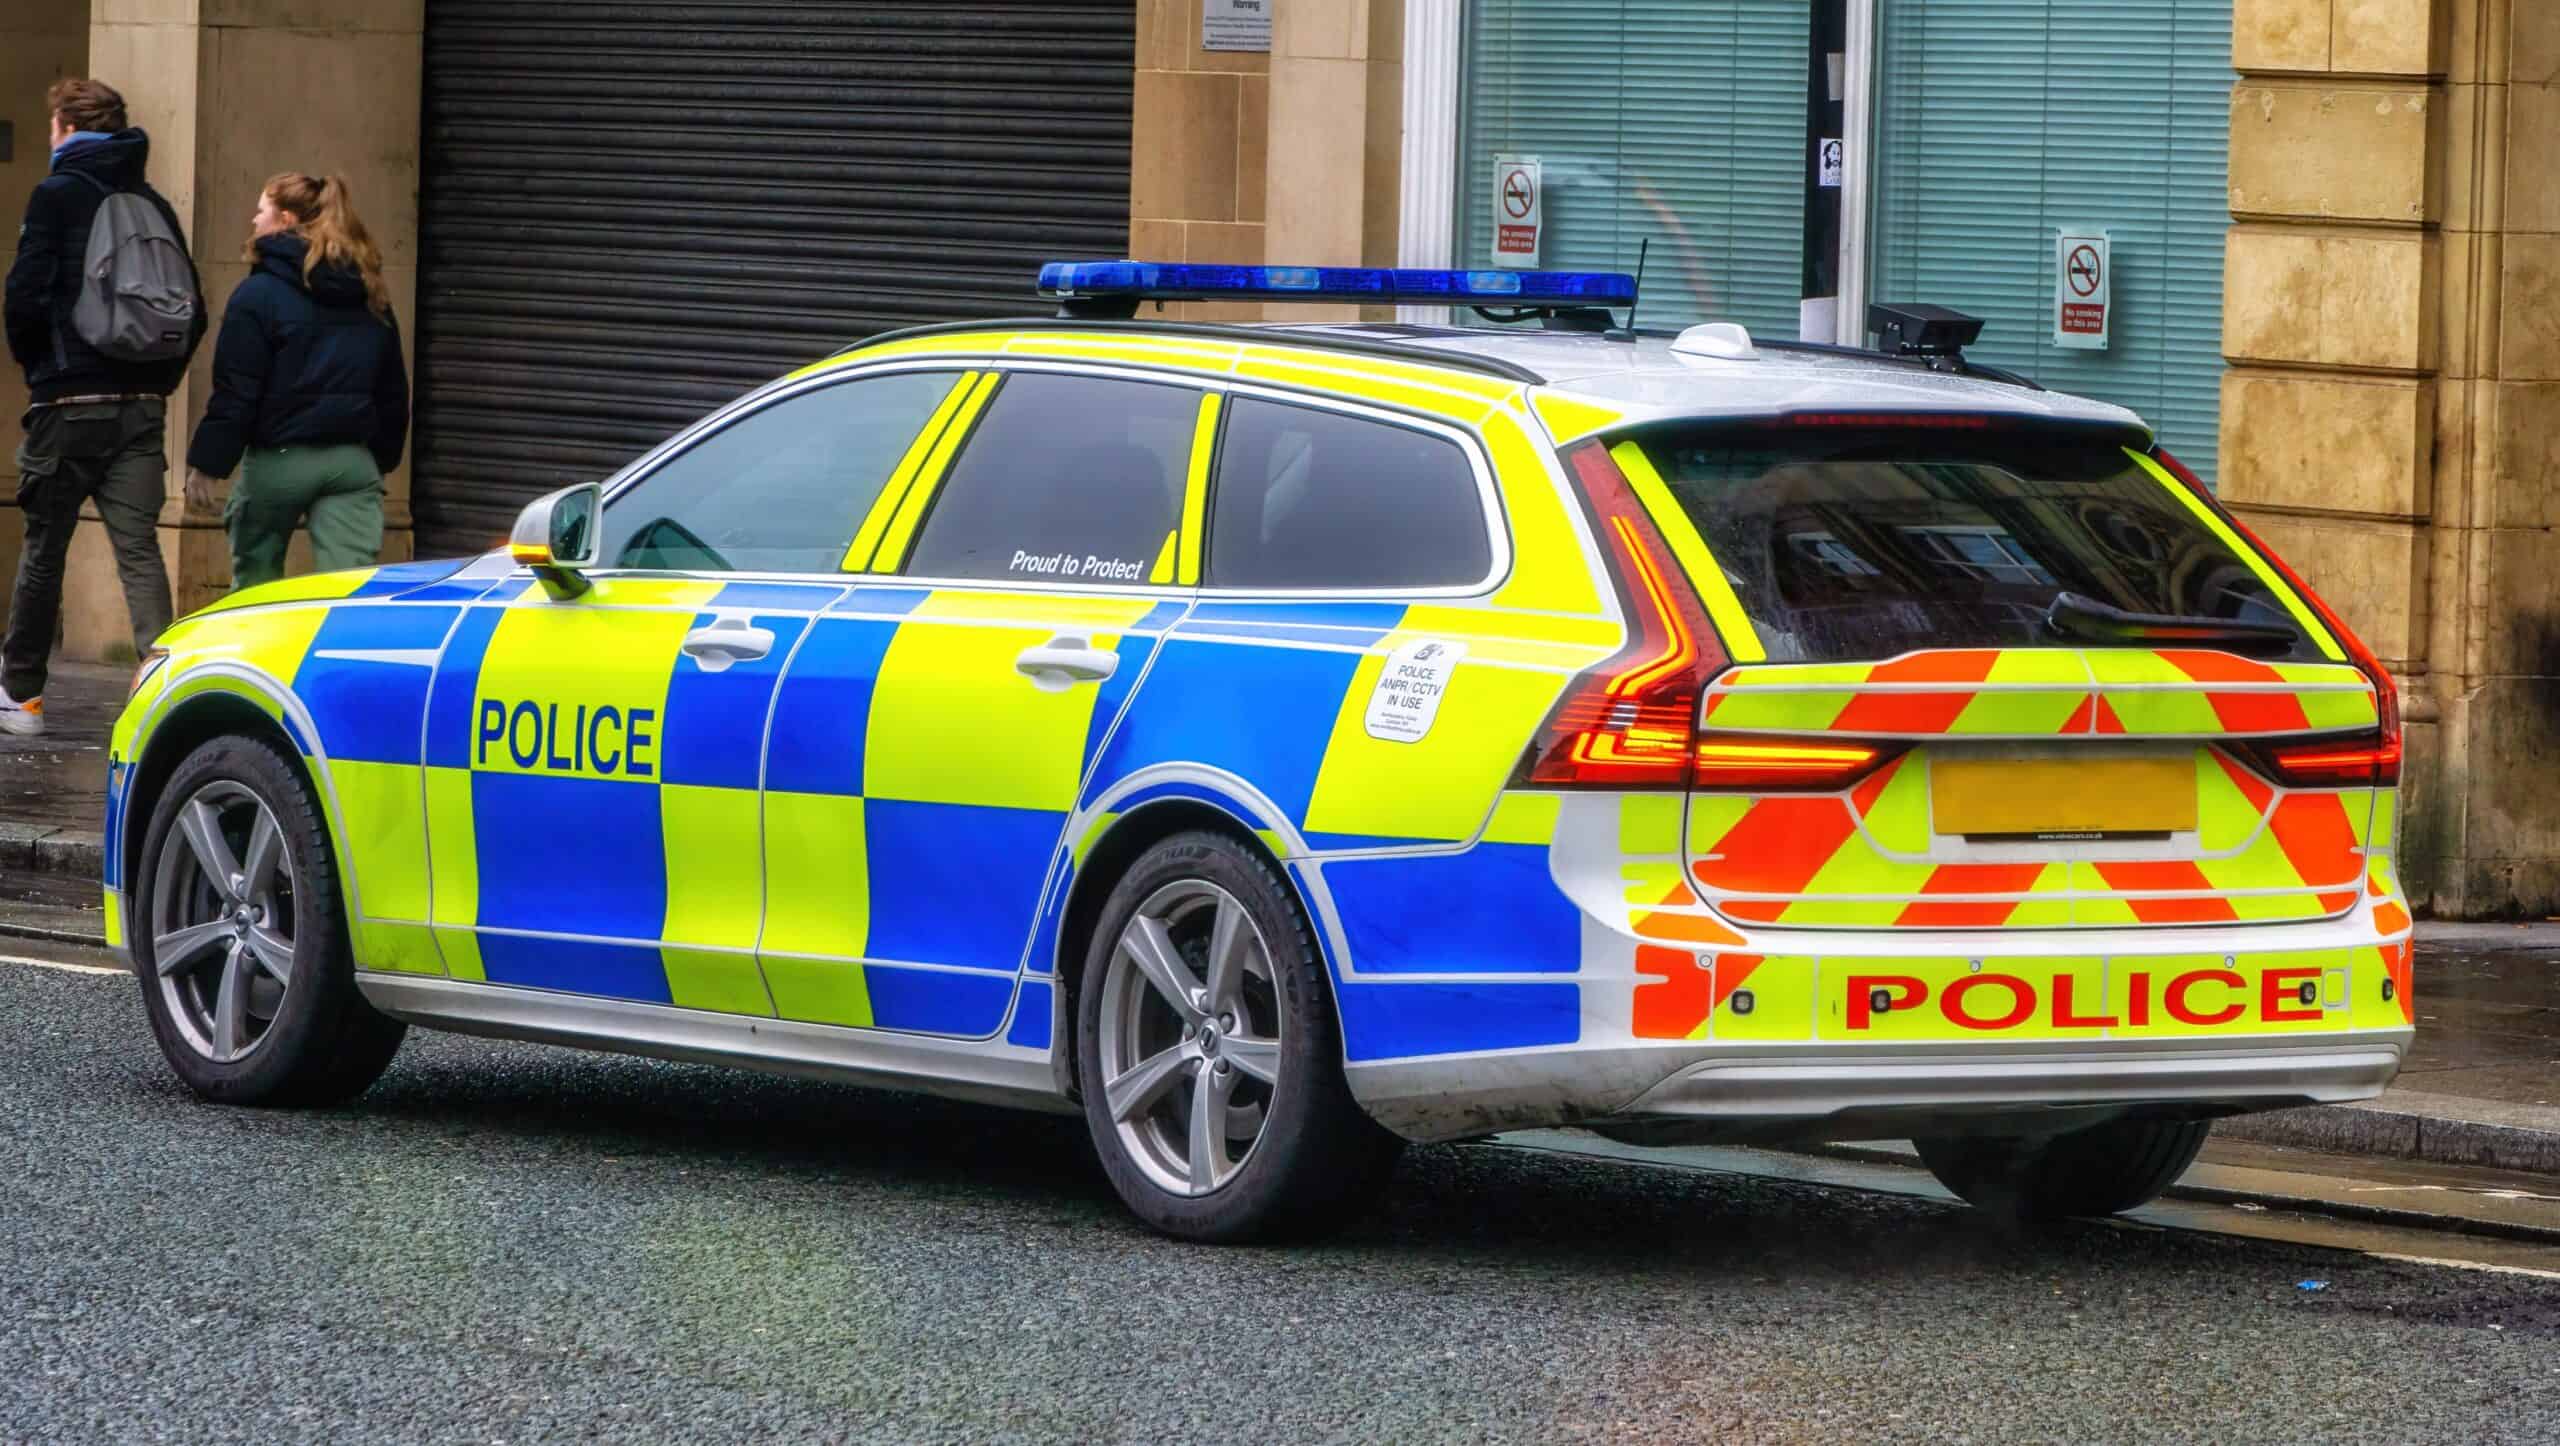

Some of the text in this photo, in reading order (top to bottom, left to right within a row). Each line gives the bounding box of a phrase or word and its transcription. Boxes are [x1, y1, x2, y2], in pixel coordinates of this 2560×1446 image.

[2065, 308, 2102, 320] No smoking
[1009, 550, 1144, 580] Proud to Protect
[1398, 664, 1437, 680] POLICE
[1387, 694, 1424, 710] IN USE
[478, 698, 655, 776] POLICE
[1846, 967, 2324, 1030] POLICE
